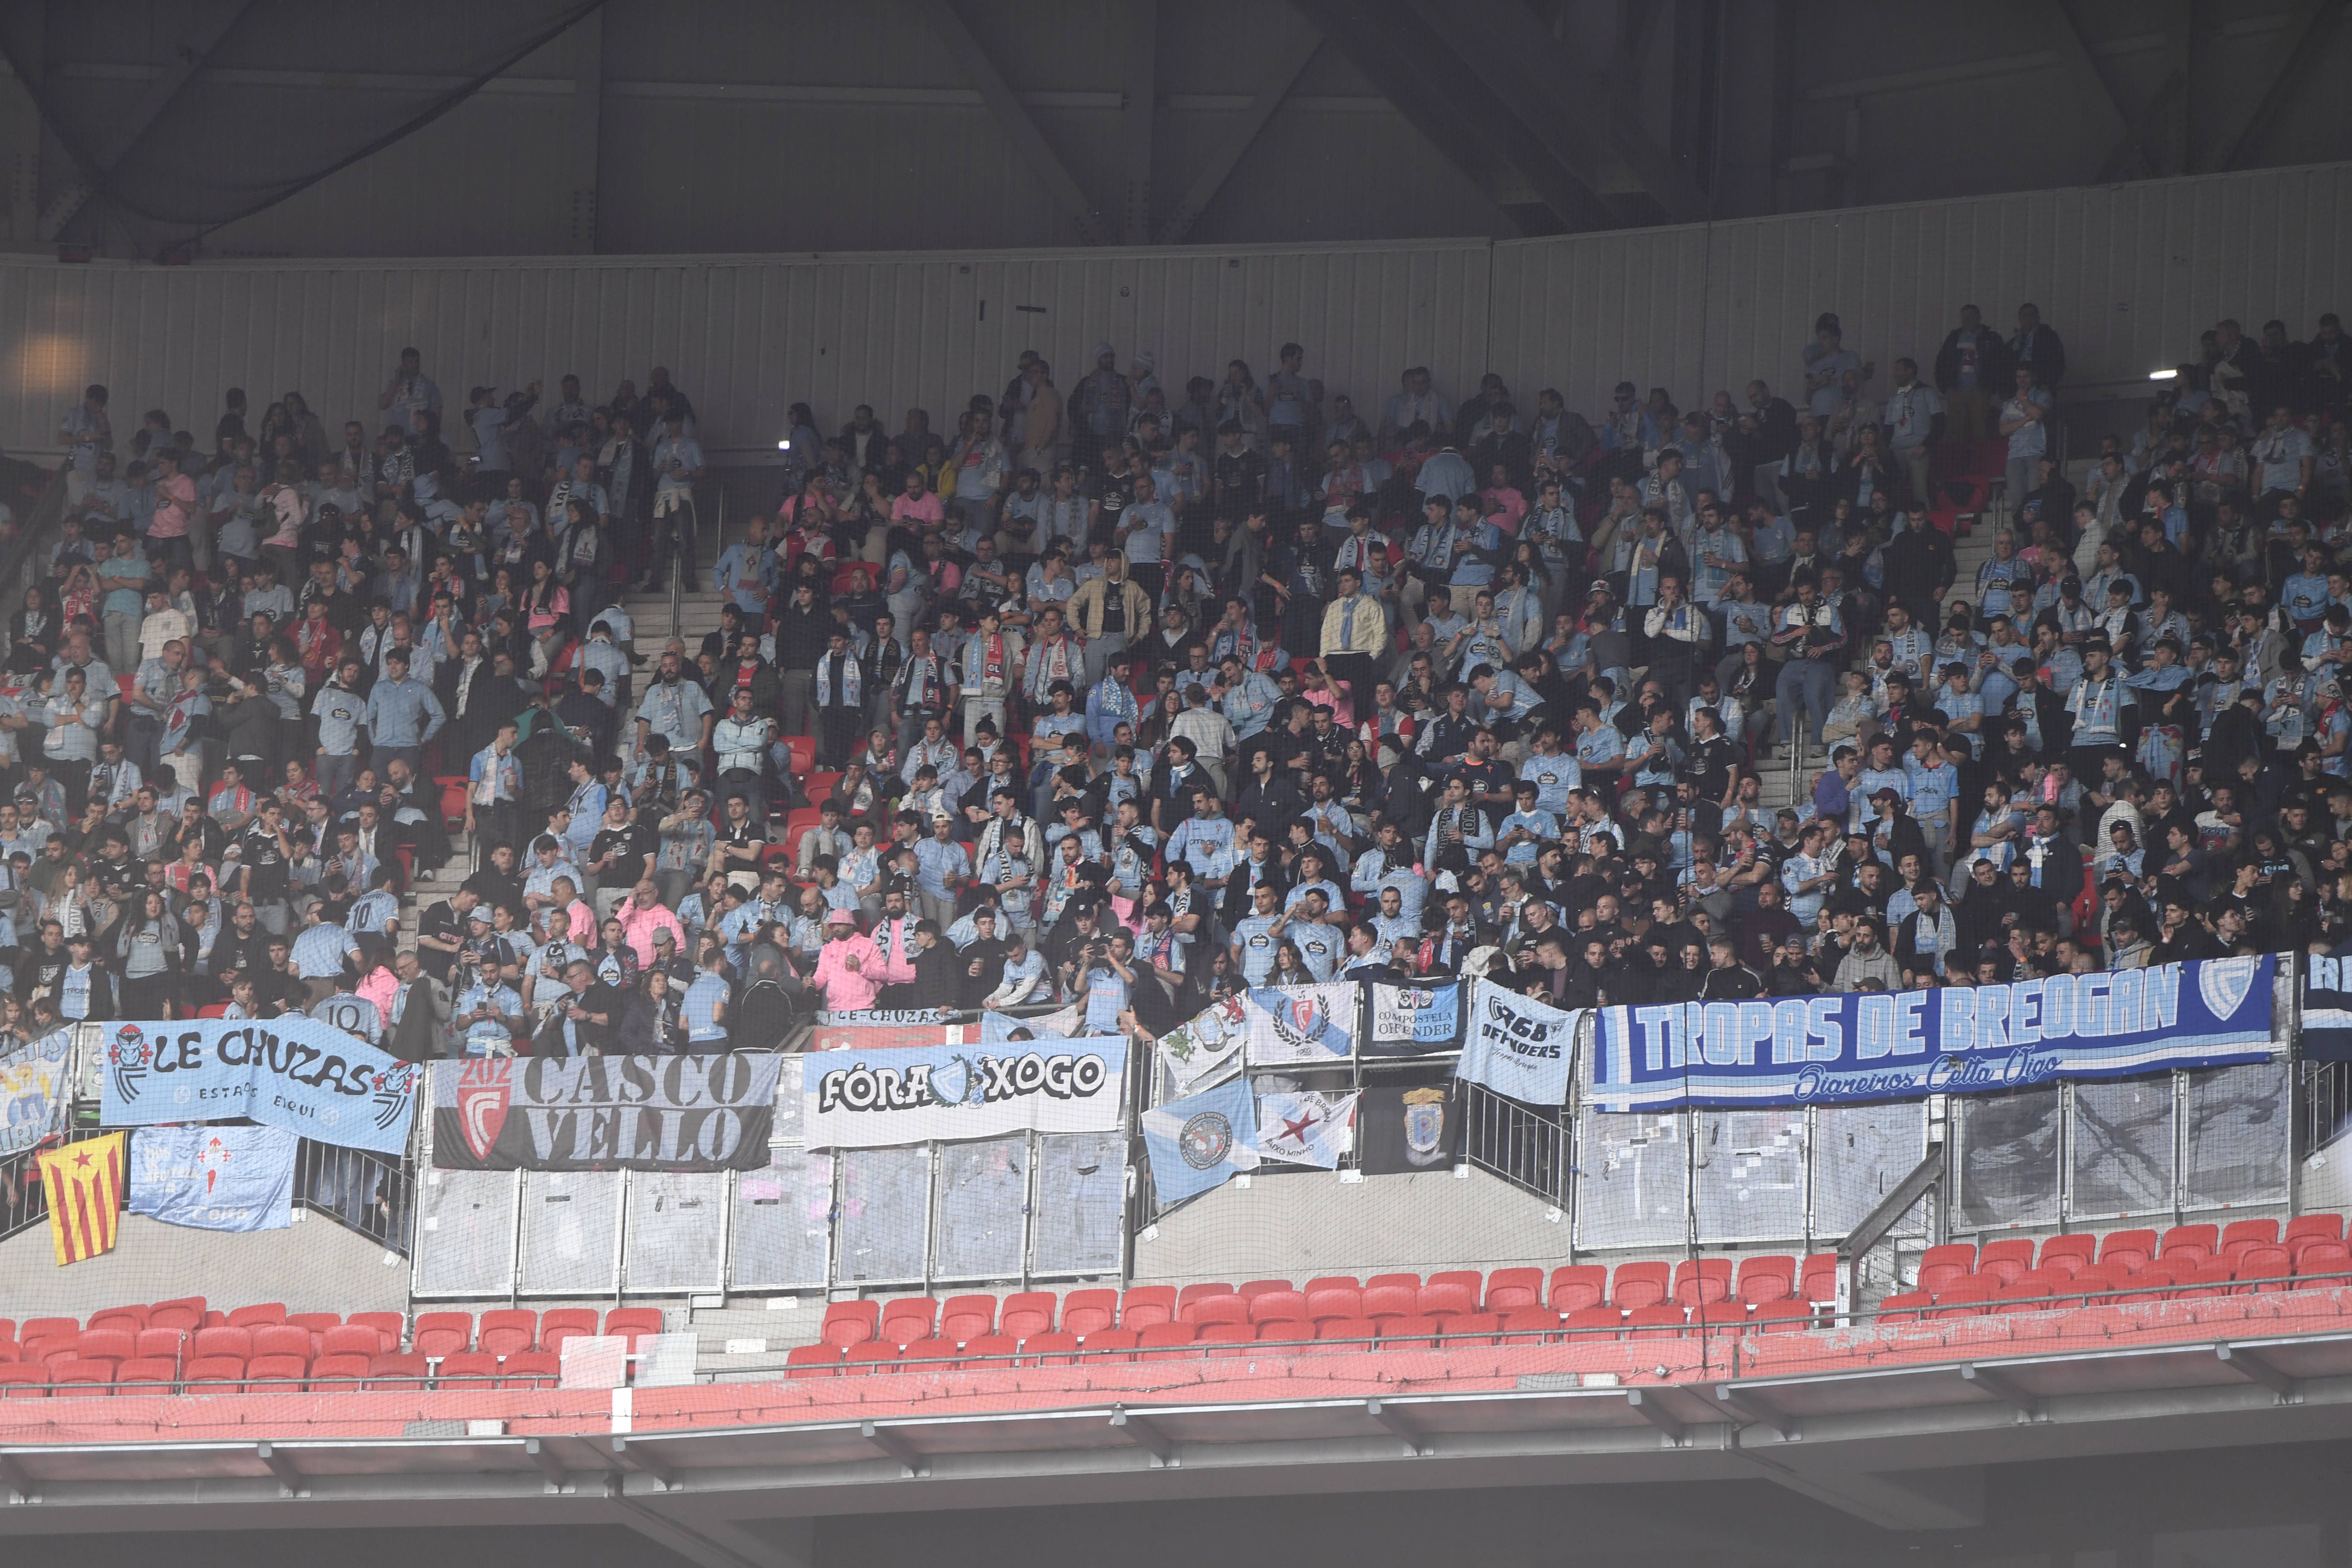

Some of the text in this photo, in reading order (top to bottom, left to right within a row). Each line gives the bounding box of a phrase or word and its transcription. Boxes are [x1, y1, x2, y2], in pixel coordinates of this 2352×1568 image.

[352, 902, 371, 929] 10
[327, 1004, 360, 1031] 10
[1378, 1011, 1453, 1024] COMPOSTELA
[1378, 1023, 1452, 1037] OFFENDER
[1635, 997, 1843, 1071] TROPAS
[1856, 989, 1928, 1061] DE
[154, 1028, 375, 1097] LE CHUZAS
[459, 1057, 513, 1085] 202
[524, 1054, 751, 1106] CASCO
[819, 1051, 1107, 1113] FÓRA XOGO
[1793, 1044, 2063, 1102] Siareiros Celta Vigo
[525, 1106, 742, 1161] VELLO
[1266, 1138, 1314, 1157] BAIXO MINHO
